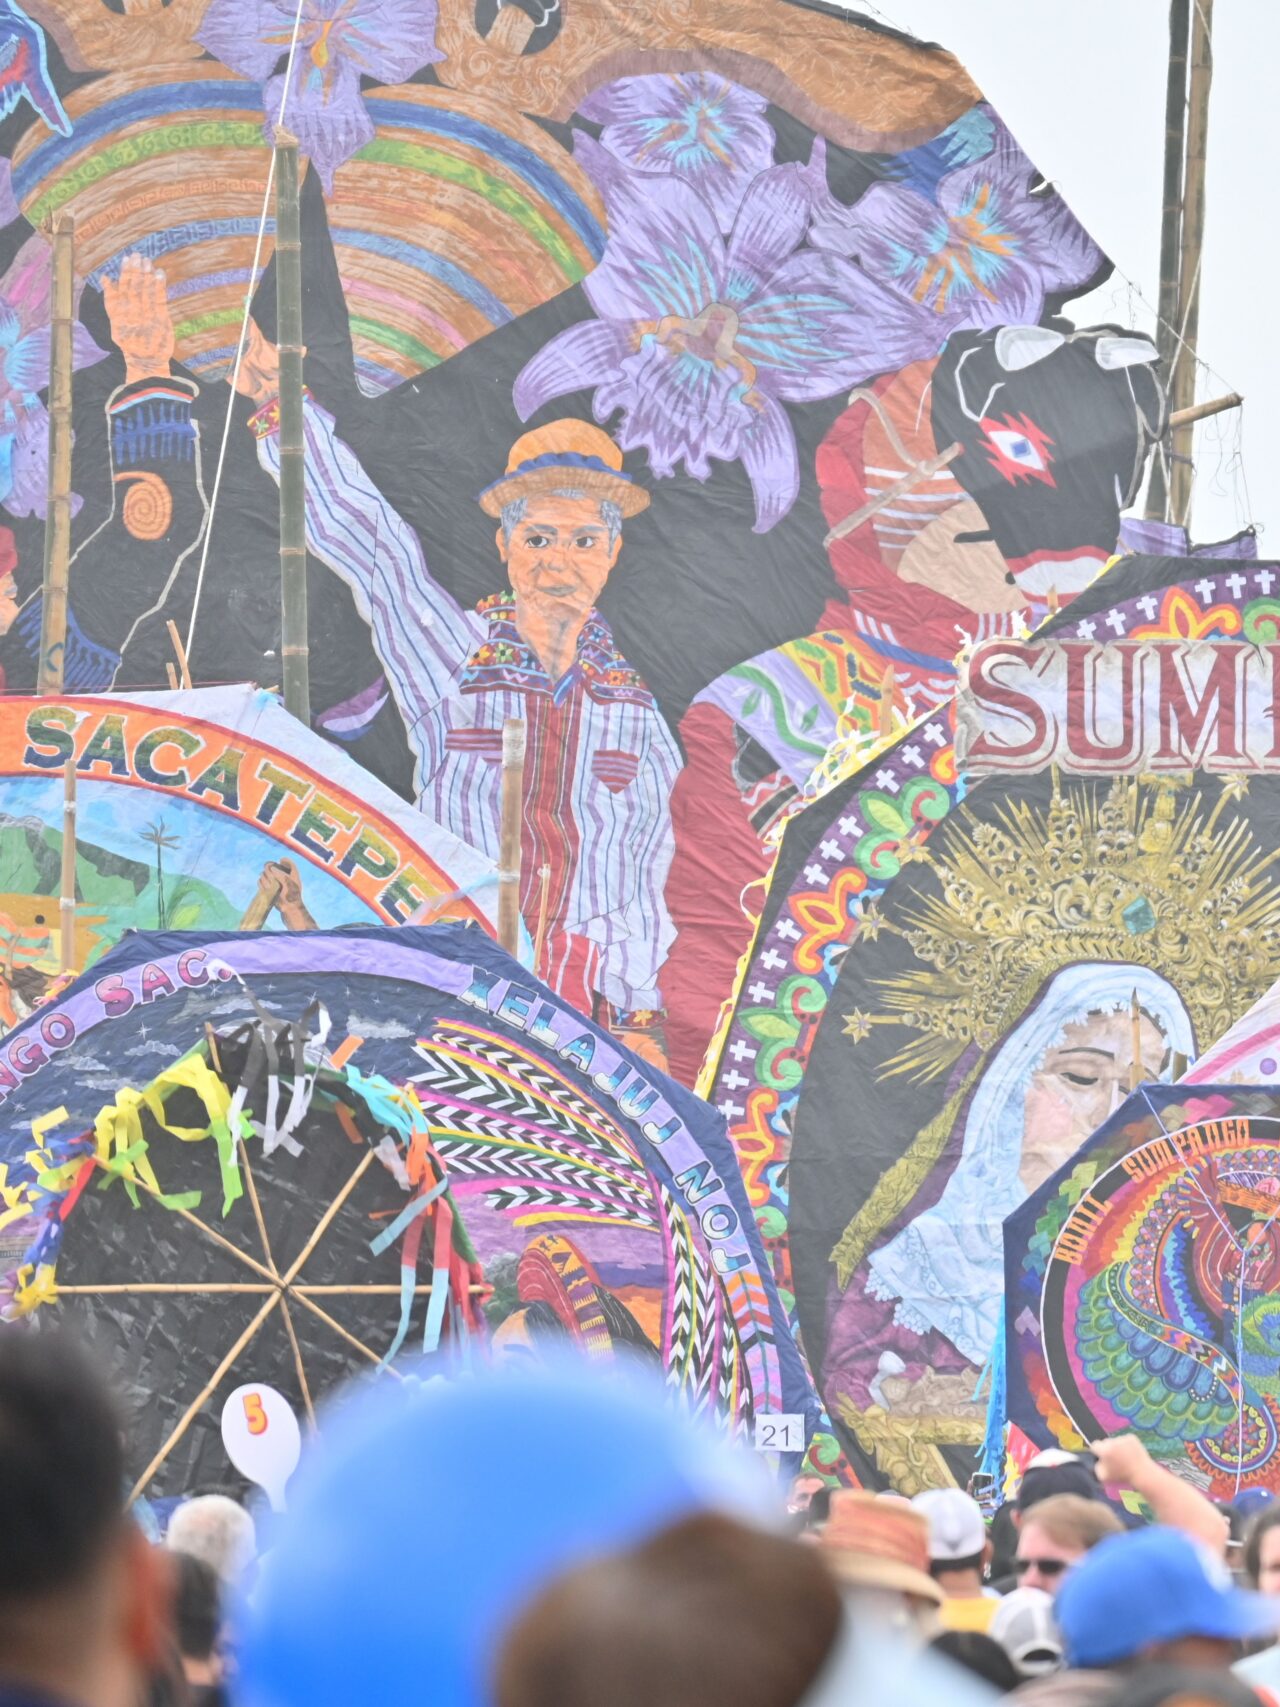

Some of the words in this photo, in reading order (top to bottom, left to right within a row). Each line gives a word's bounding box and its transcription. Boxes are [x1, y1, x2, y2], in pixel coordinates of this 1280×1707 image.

[94, 949, 234, 1018] SAC.
[457, 963, 683, 1147] XELAJUJ
[673, 1158, 753, 1275] NOJ
[1120, 1118, 1250, 1184] SUMPANGO
[242, 1393, 268, 1435] 5
[761, 1424, 790, 1448] 21
